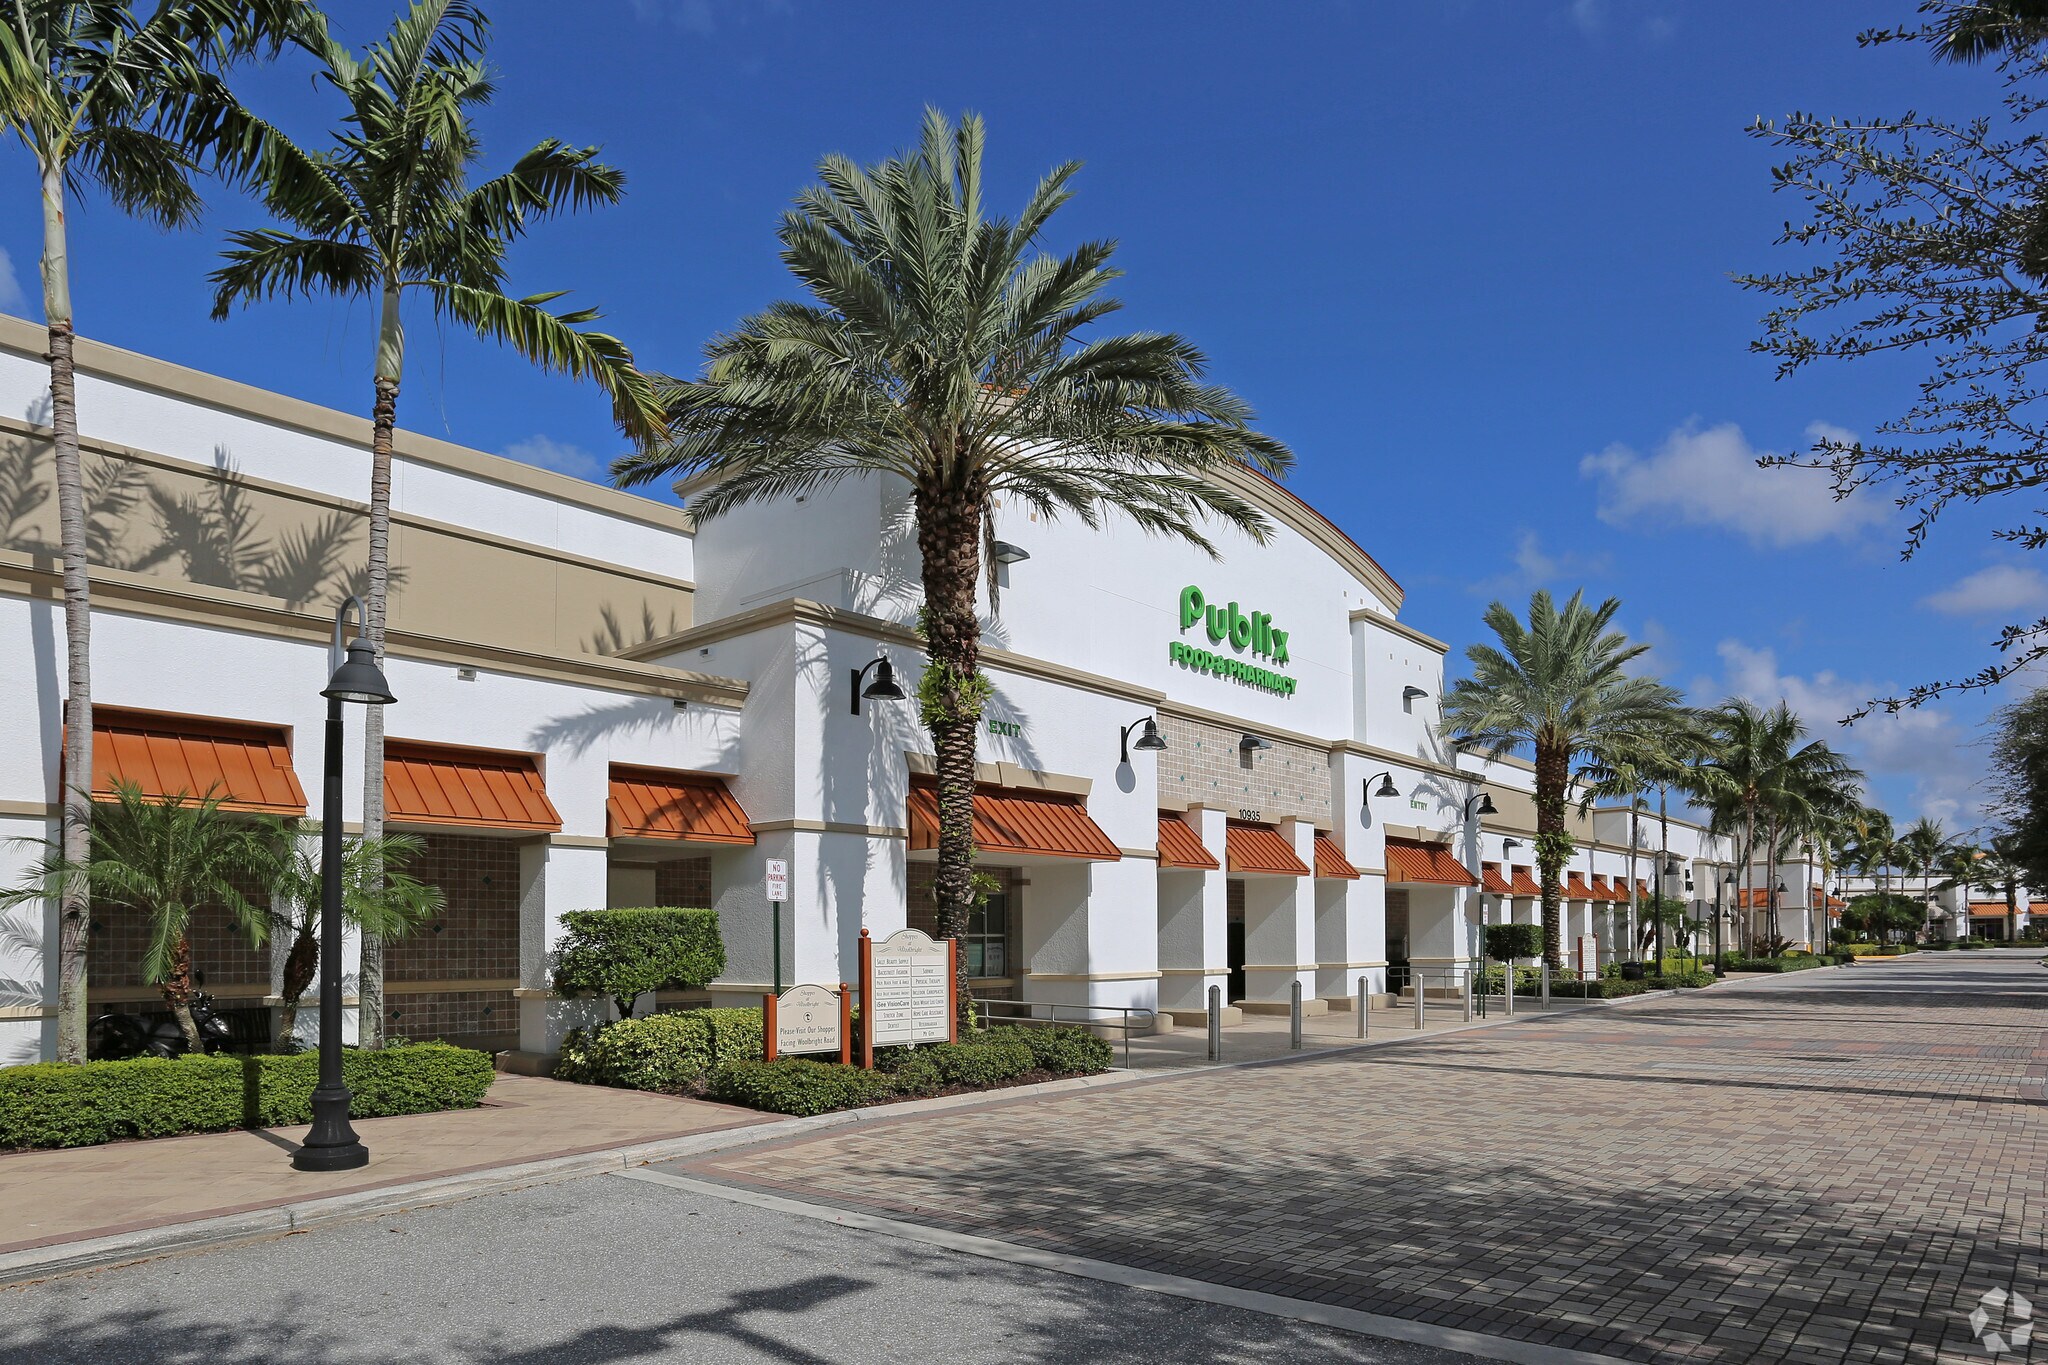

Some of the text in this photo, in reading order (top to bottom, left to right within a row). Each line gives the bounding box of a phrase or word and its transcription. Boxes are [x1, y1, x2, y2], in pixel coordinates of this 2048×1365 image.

[1180, 585, 1289, 662] Publix
[989, 719, 1020, 737] EXIT
[1410, 800, 1428, 811] ENTRY
[1239, 809, 1260, 821] 10935
[773, 864, 780, 872] NO
[768, 874, 786, 882] PARKING
[818, 1026, 835, 1034] Shoppes
[781, 1040, 795, 1048] Facing
[797, 1038, 822, 1046] Woolbright
